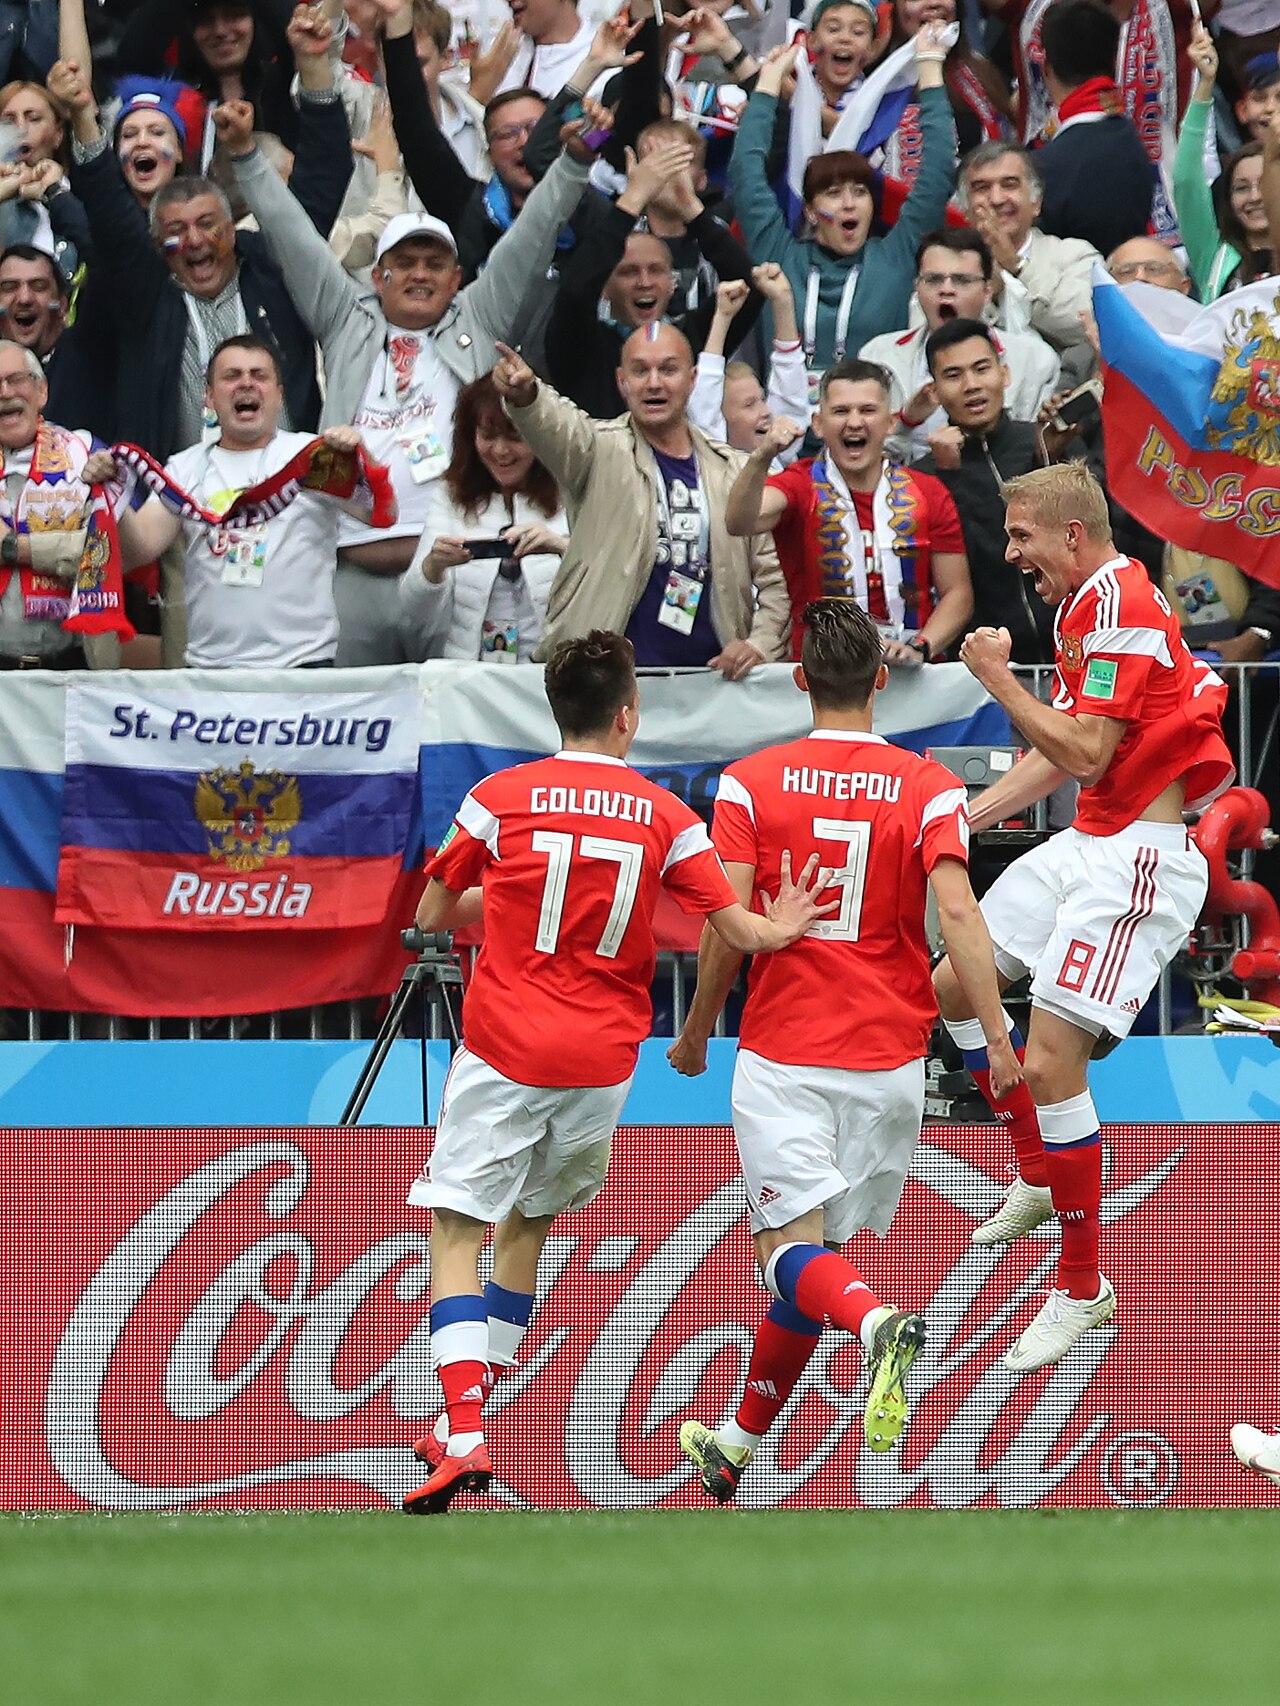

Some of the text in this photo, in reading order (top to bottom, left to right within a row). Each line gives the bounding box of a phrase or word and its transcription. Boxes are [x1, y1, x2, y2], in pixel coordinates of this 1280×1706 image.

[110, 704, 393, 752] St. Petersburg
[530, 787, 654, 826] GOLOVIN
[782, 766, 903, 803] KUTEPOV
[163, 871, 313, 919] Russia
[531, 830, 646, 959] 17
[804, 816, 873, 942] 3
[1056, 938, 1097, 993] 8
